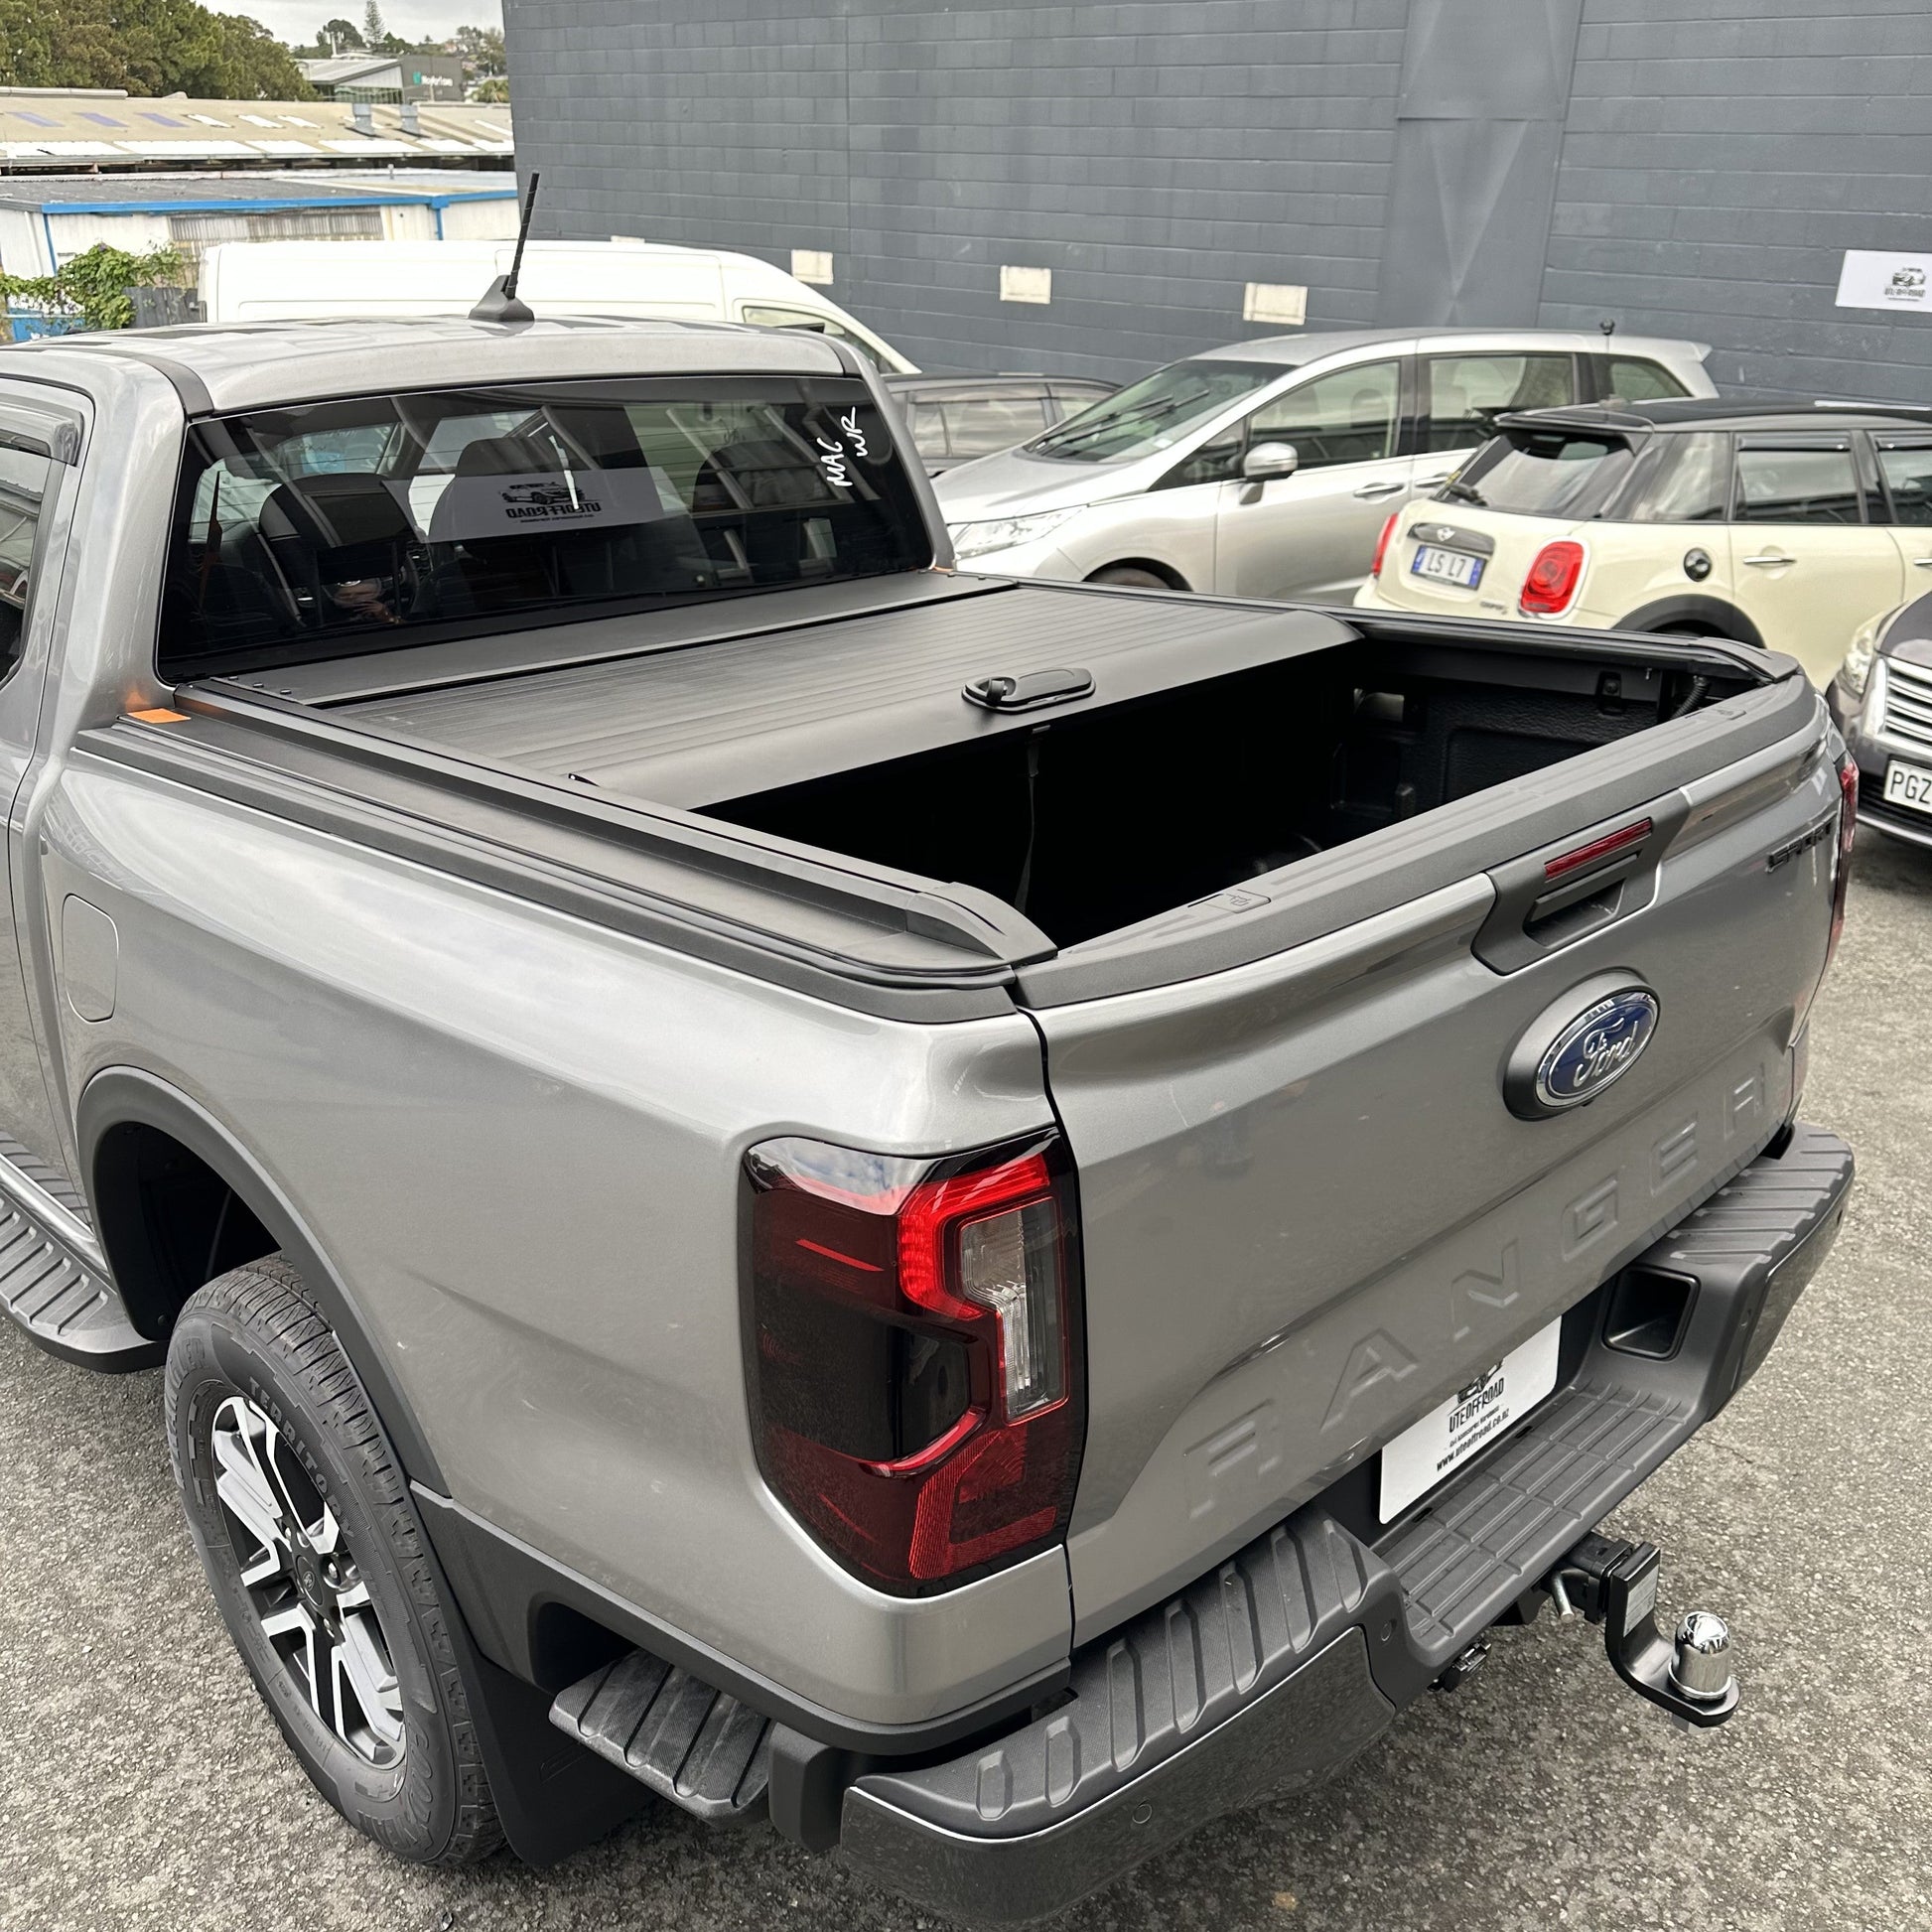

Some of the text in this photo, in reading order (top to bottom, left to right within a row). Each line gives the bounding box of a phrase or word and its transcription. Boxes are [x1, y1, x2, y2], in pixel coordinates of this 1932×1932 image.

[816, 437, 853, 486] MAC
[1427, 551, 1446, 574] LS
[1890, 769, 1931, 805] PGZ
[1573, 1017, 1638, 1088] Ford
[1183, 1060, 1765, 1519] RANGER
[1449, 1377, 1504, 1433] UTEOFFROAD
[249, 1375, 355, 1538] TERRITORY
